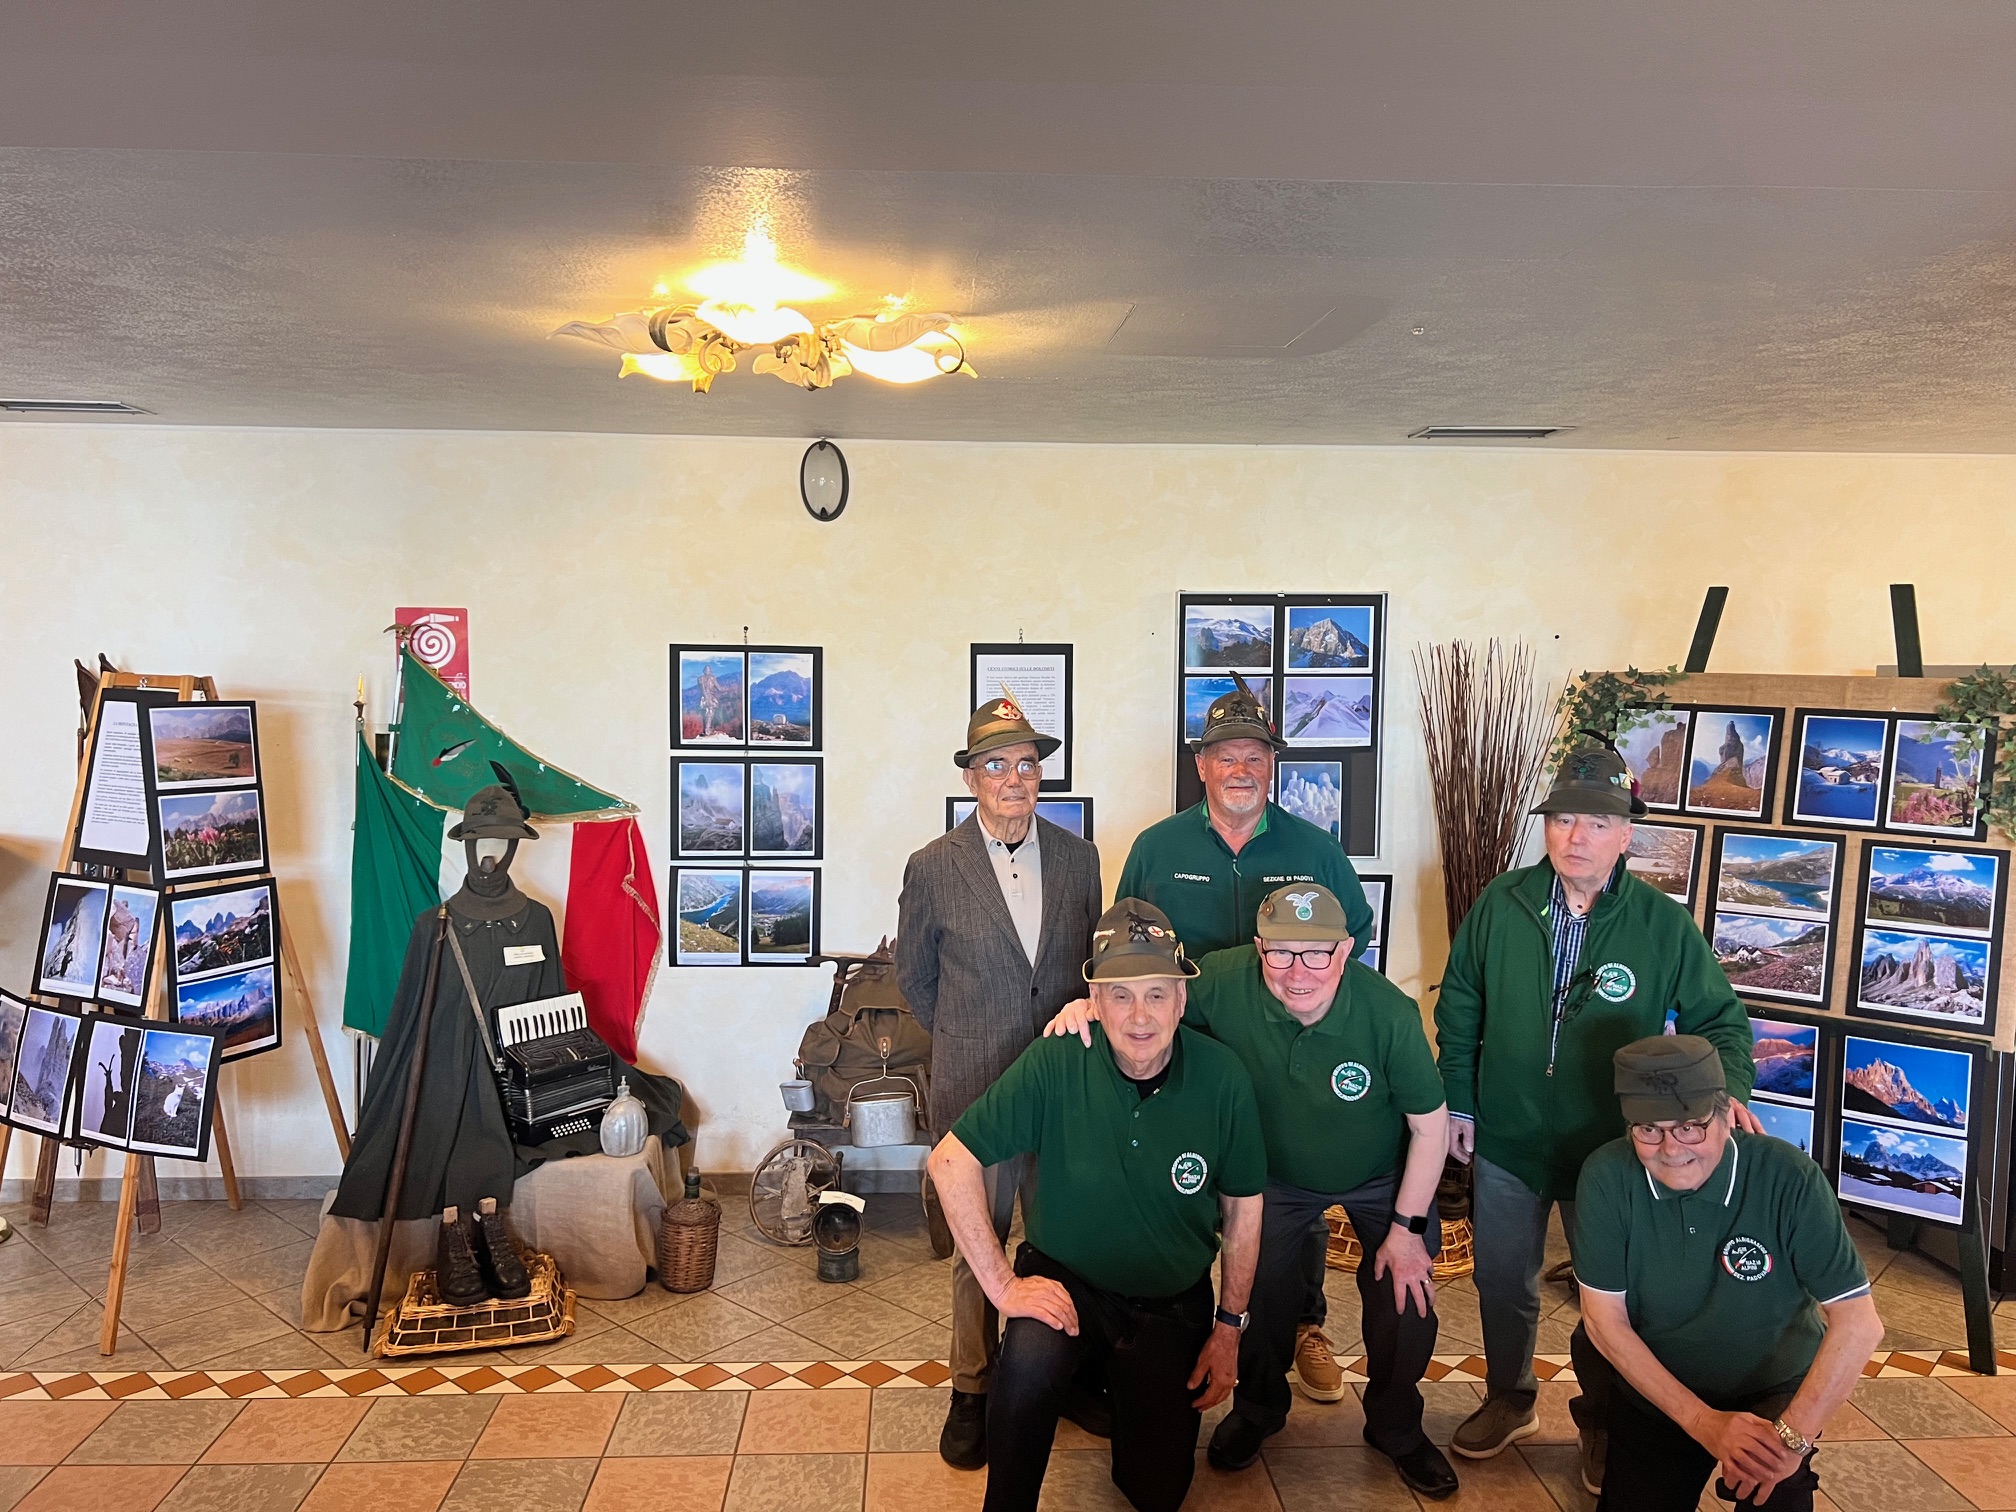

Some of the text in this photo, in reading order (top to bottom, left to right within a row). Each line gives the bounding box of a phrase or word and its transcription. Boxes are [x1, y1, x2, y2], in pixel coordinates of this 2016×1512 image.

[1174, 872, 1210, 882] CAPOGRUPPO
[1293, 874, 1314, 882] PADOVA
[1722, 1239, 1736, 1255] GRUPPO
[1735, 1236, 1768, 1254] ALBIGNASEGO
[1746, 1270, 1768, 1281] PADOVA
